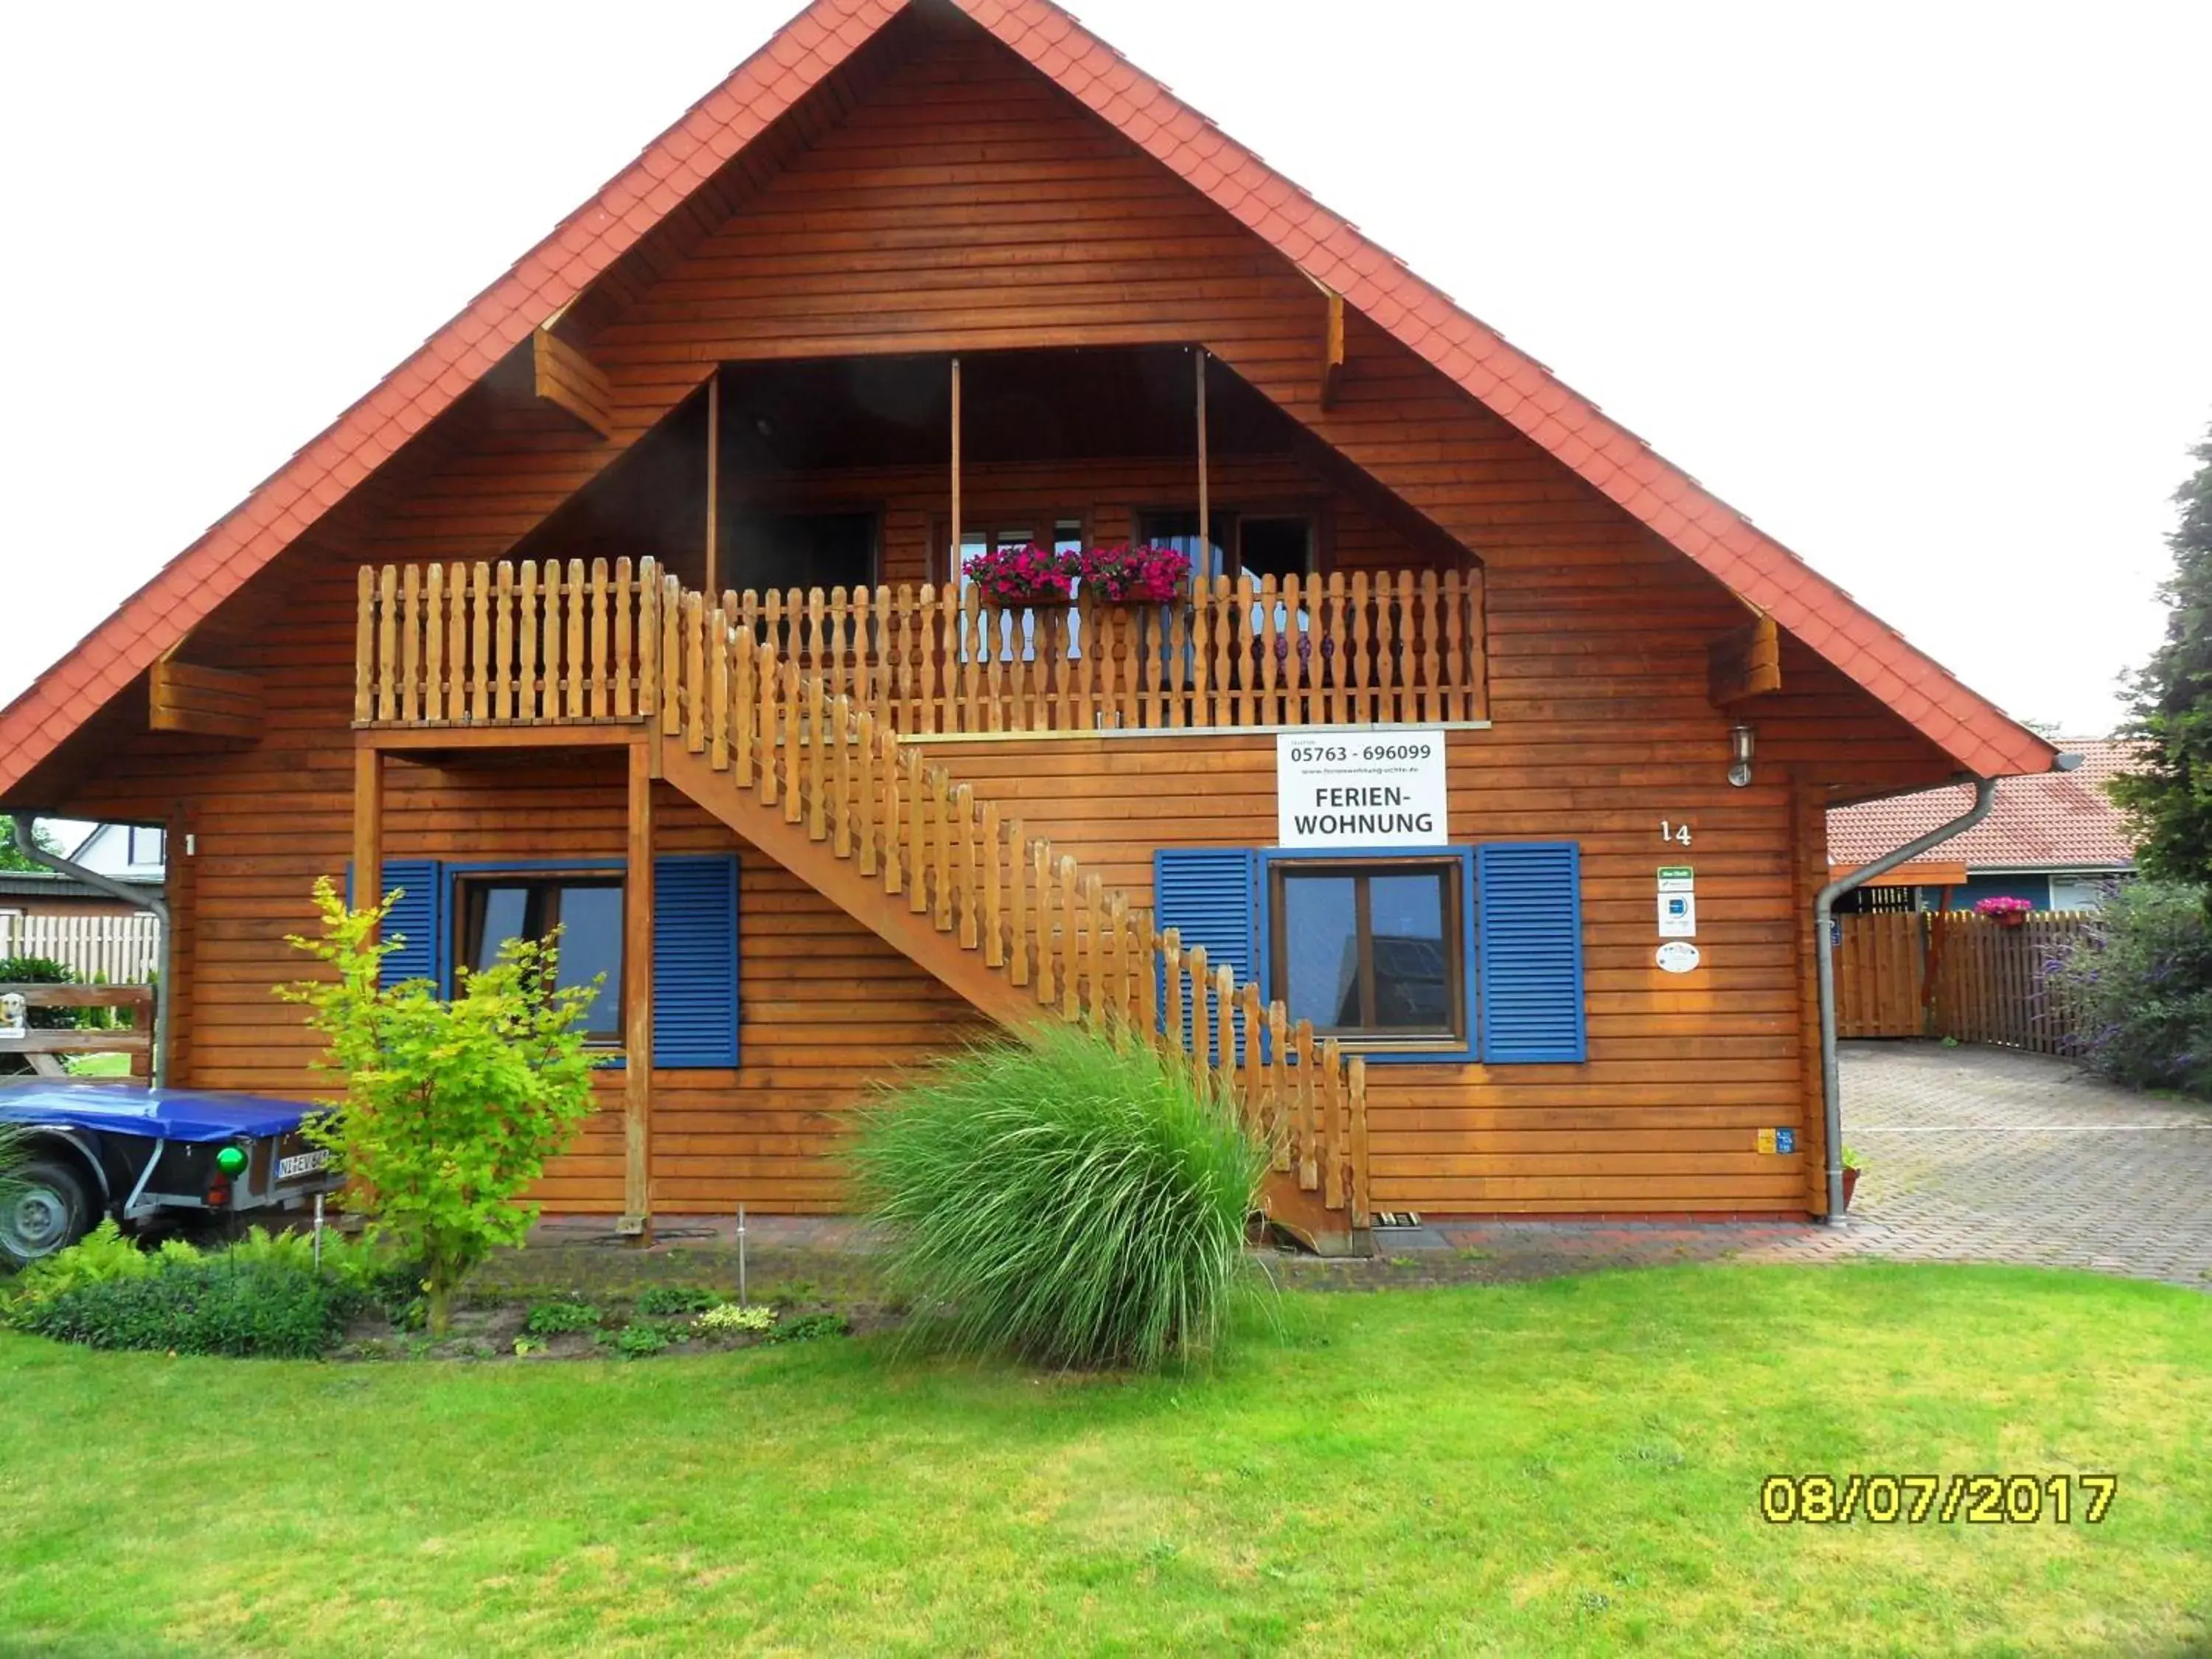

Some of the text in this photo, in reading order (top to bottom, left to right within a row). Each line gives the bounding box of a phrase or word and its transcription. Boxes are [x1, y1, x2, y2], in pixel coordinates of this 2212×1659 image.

[1291, 747, 1347, 762] 05763
[1363, 745, 1431, 760] 696099
[1316, 787, 1411, 807] FERIEN-
[1295, 813, 1433, 835] WOHNUNG
[1660, 820, 1691, 846] 14
